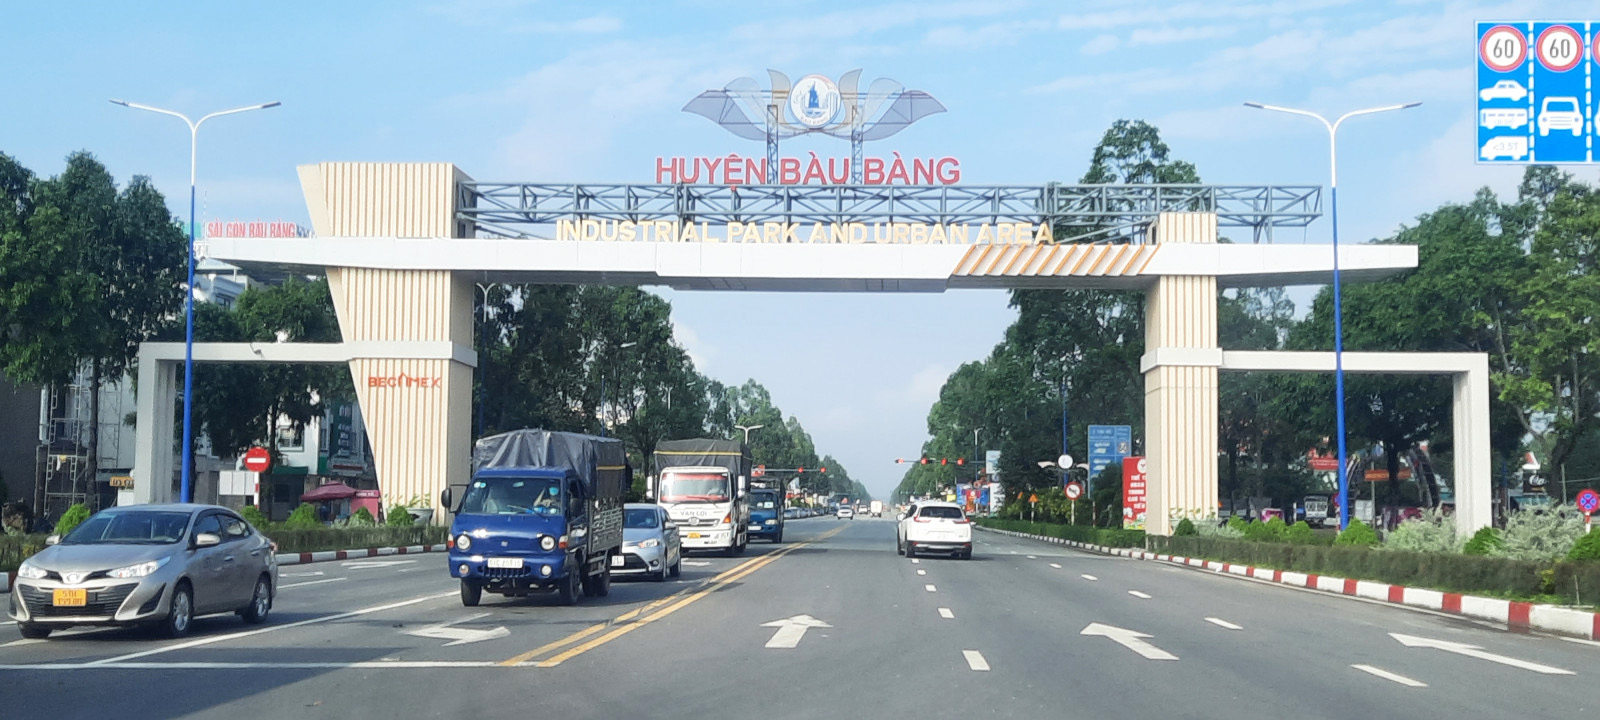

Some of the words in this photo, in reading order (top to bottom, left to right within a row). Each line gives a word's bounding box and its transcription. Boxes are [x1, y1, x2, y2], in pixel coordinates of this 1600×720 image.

[1493, 38, 1514, 59] 60
[1549, 38, 1570, 59] 60
[779, 151, 850, 185] BÀU
[863, 151, 960, 185] BÀNG
[556, 219, 720, 243] INDUSTRIAL
[727, 221, 801, 244] PARK
[808, 221, 868, 245] AND
[874, 221, 969, 245] URBAN
[970, 221, 1055, 246] AREA
[367, 372, 441, 389] BECAMEX
